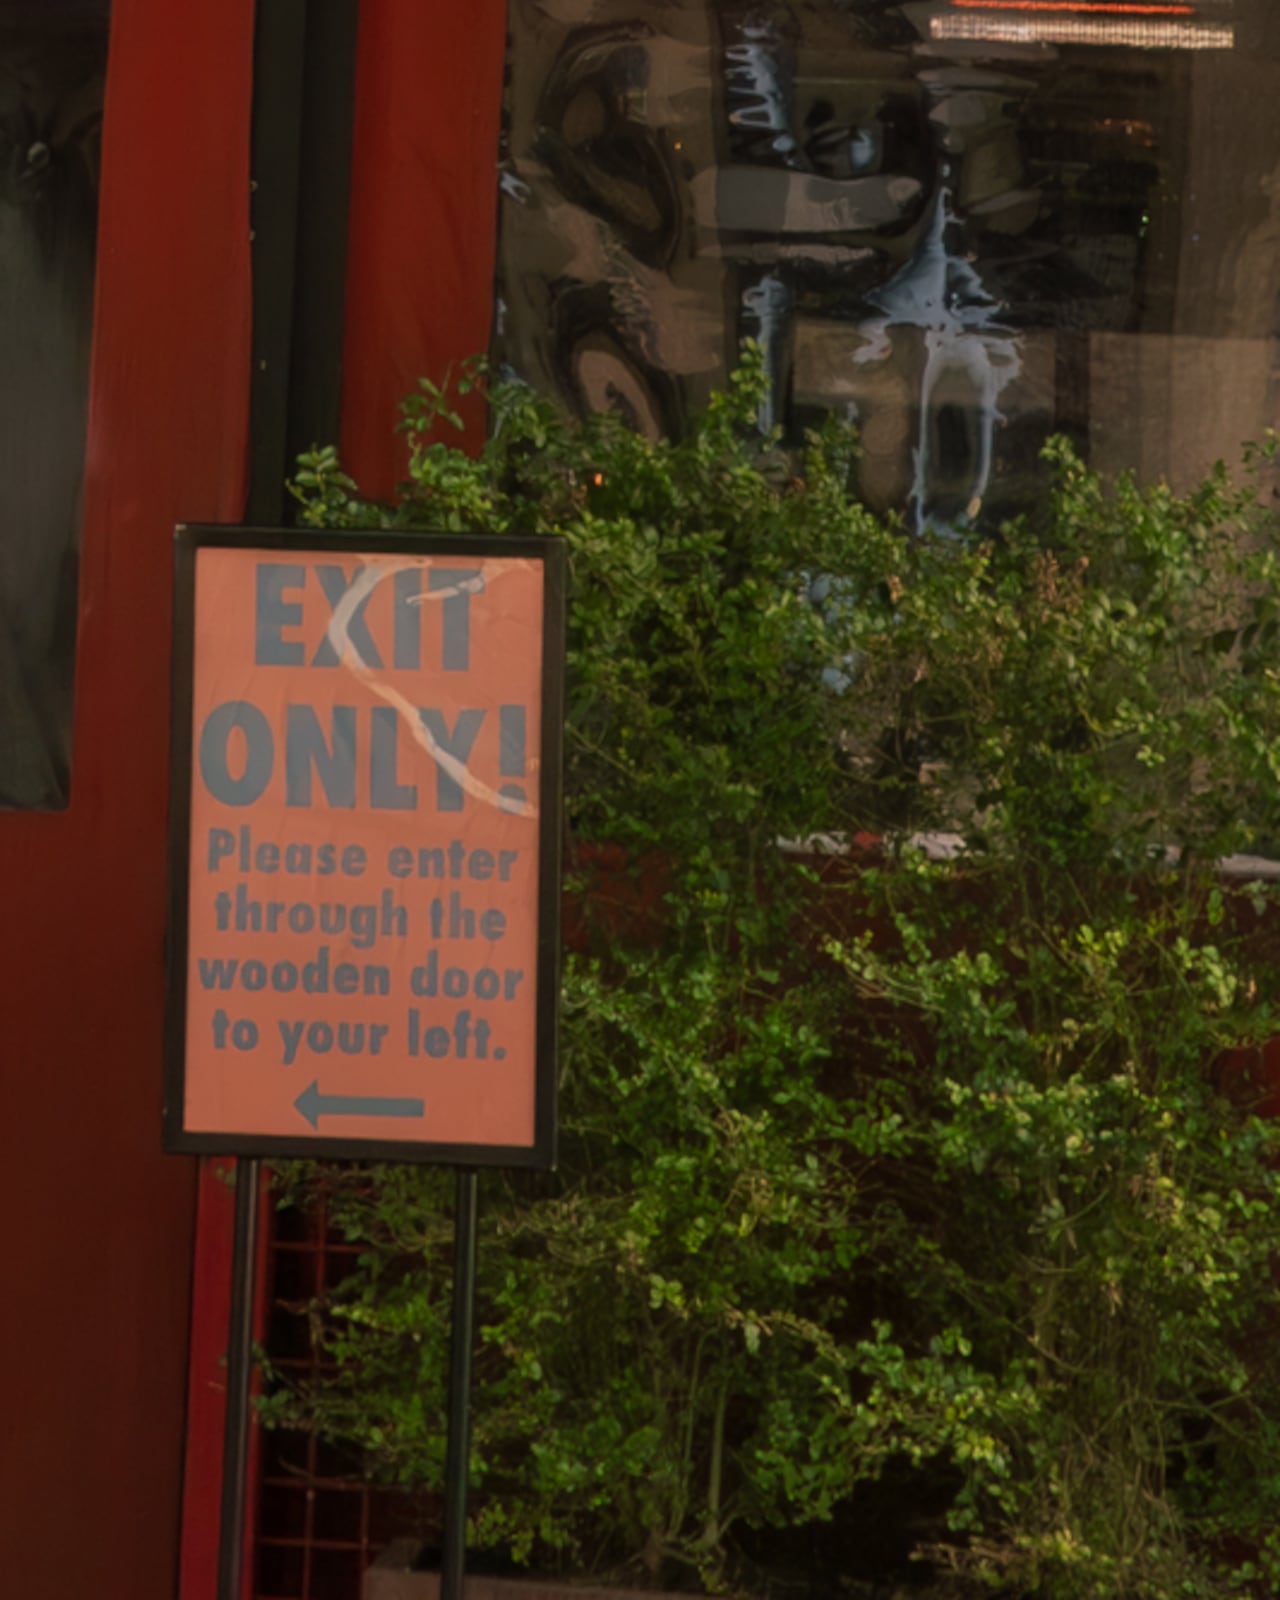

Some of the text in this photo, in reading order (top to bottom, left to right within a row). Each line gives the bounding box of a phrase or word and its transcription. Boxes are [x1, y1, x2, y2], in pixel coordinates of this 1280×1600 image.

[254, 563, 487, 672] EXIT
[198, 701, 528, 816] ONLY!
[207, 825, 518, 882] Please enter
[214, 884, 507, 949] through the
[197, 947, 524, 1001] wooden door
[211, 1008, 507, 1066] to your left.
